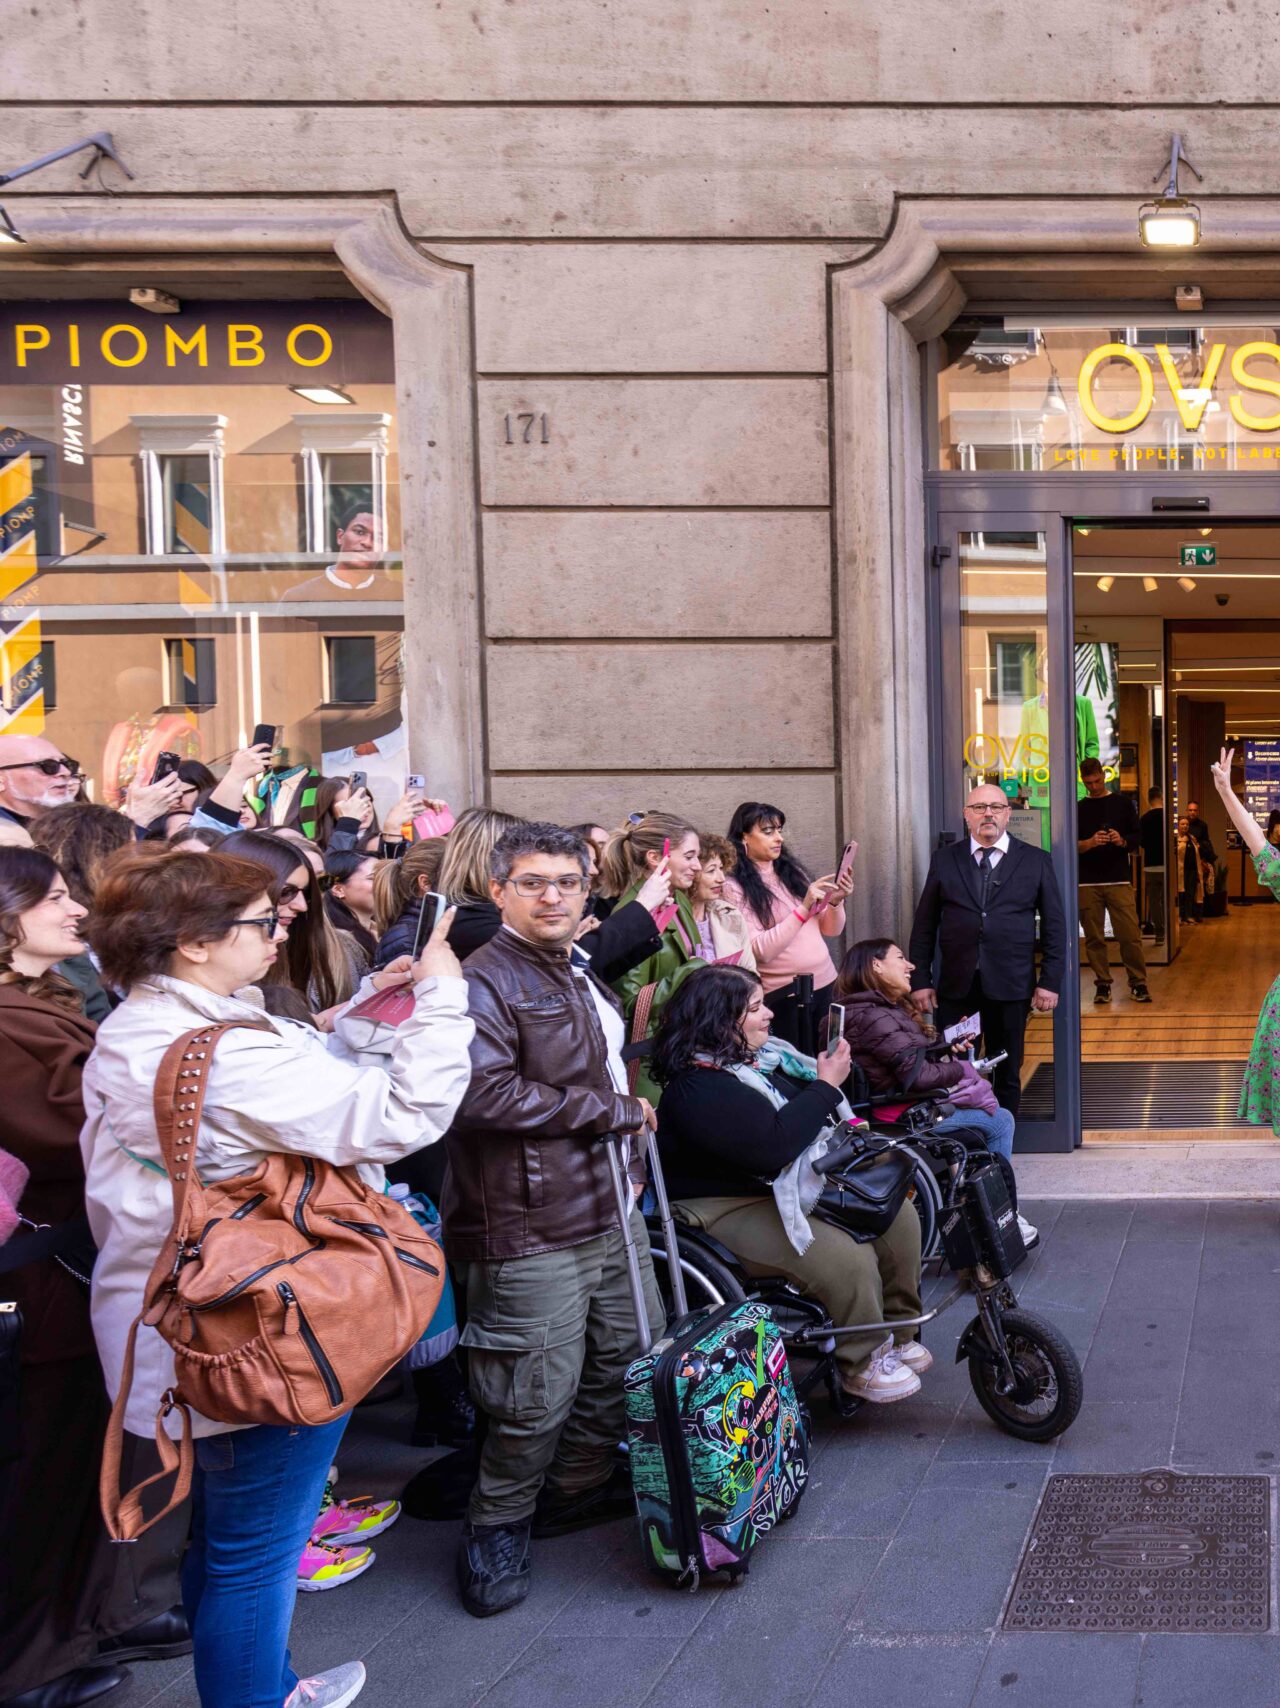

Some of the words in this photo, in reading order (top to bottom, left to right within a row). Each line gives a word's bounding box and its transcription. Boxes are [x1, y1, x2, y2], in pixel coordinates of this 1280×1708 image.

[15, 323, 333, 367] PIOMBO
[504, 412, 549, 445] 171
[1054, 448, 1099, 461] LOVE
[1109, 448, 1185, 461] PEOPLE.
[1195, 447, 1227, 459] NOT
[964, 732, 1049, 769] OVS
